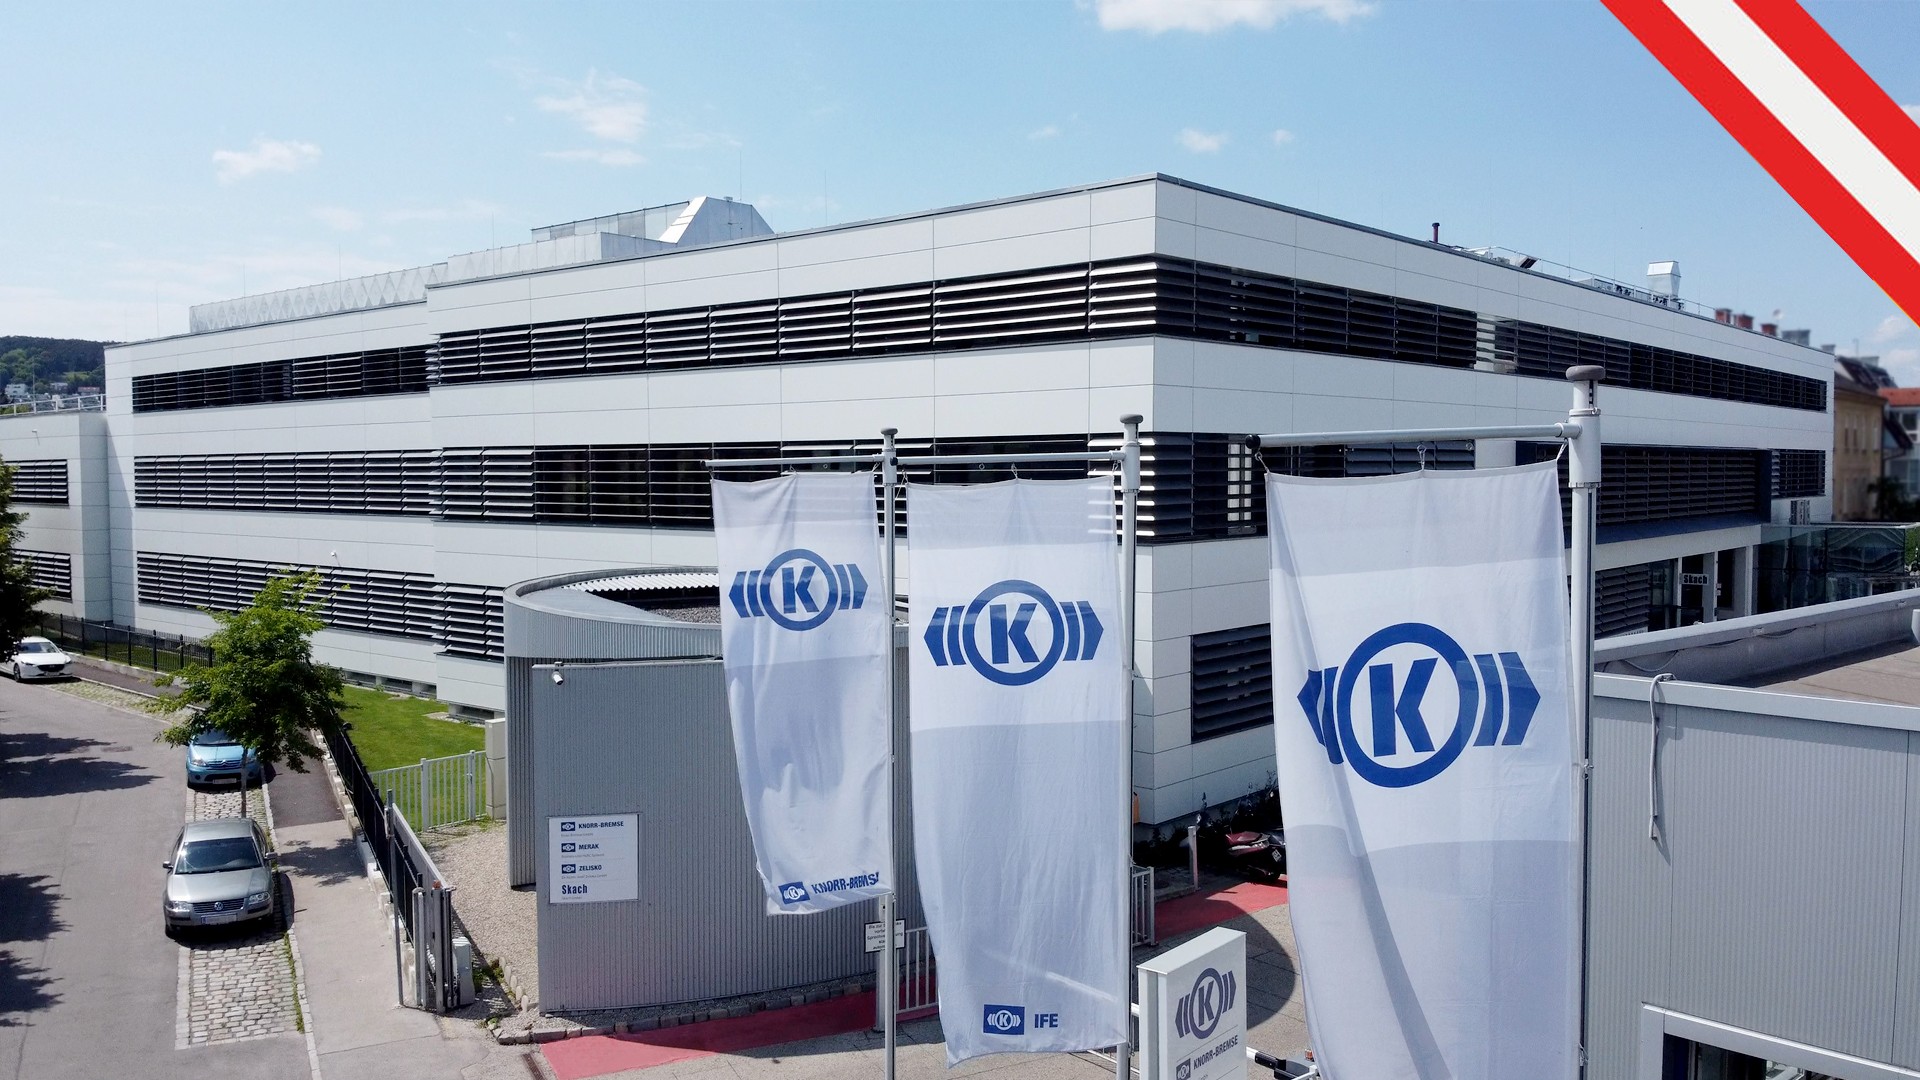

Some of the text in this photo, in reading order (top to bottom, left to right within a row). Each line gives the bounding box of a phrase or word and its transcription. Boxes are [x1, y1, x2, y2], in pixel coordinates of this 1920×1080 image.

[782, 566, 820, 614] K
[1683, 574, 1708, 585] Skach
[990, 603, 1040, 664] K
[1369, 657, 1438, 758] K
[578, 821, 624, 829] KNORR-BREMSE
[561, 884, 588, 894] Skach
[1000, 1013, 1059, 1029] K IFE
[1198, 980, 1214, 1028] K
[1193, 1034, 1238, 1070] KNORR-BREMSE
